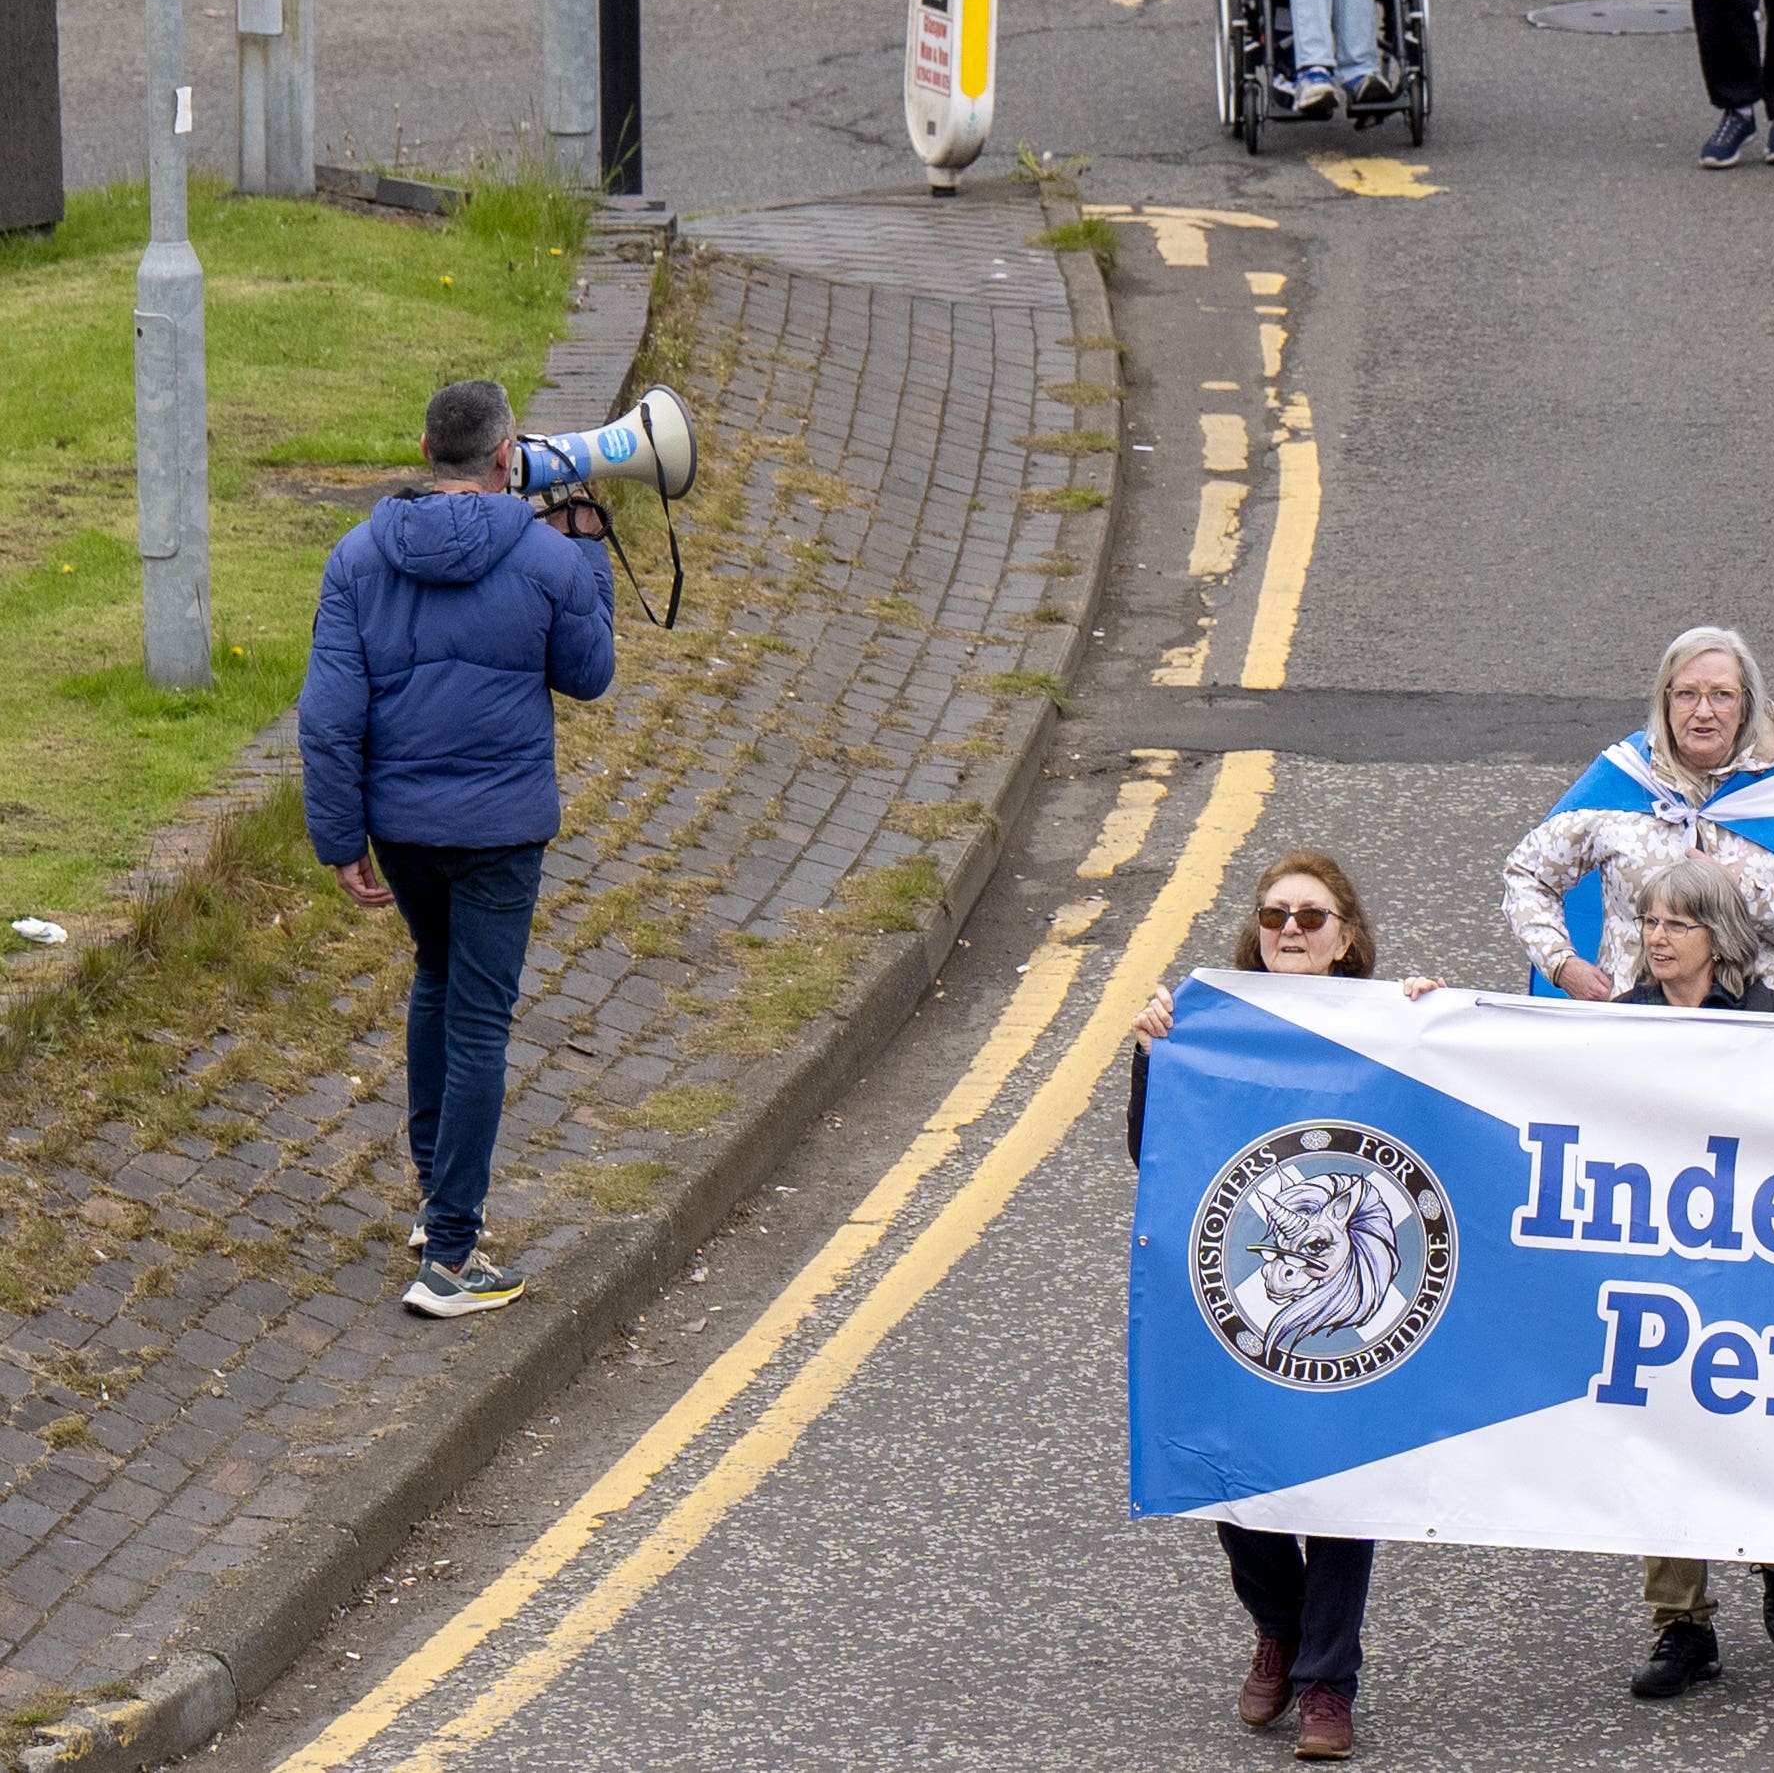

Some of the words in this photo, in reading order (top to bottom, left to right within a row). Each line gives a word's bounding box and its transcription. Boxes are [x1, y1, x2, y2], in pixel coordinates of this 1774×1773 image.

[1200, 1144, 1279, 1325] PENSIONERS
[1357, 1133, 1416, 1185] FOR
[1275, 1232, 1449, 1383] INDEPENDENCE
